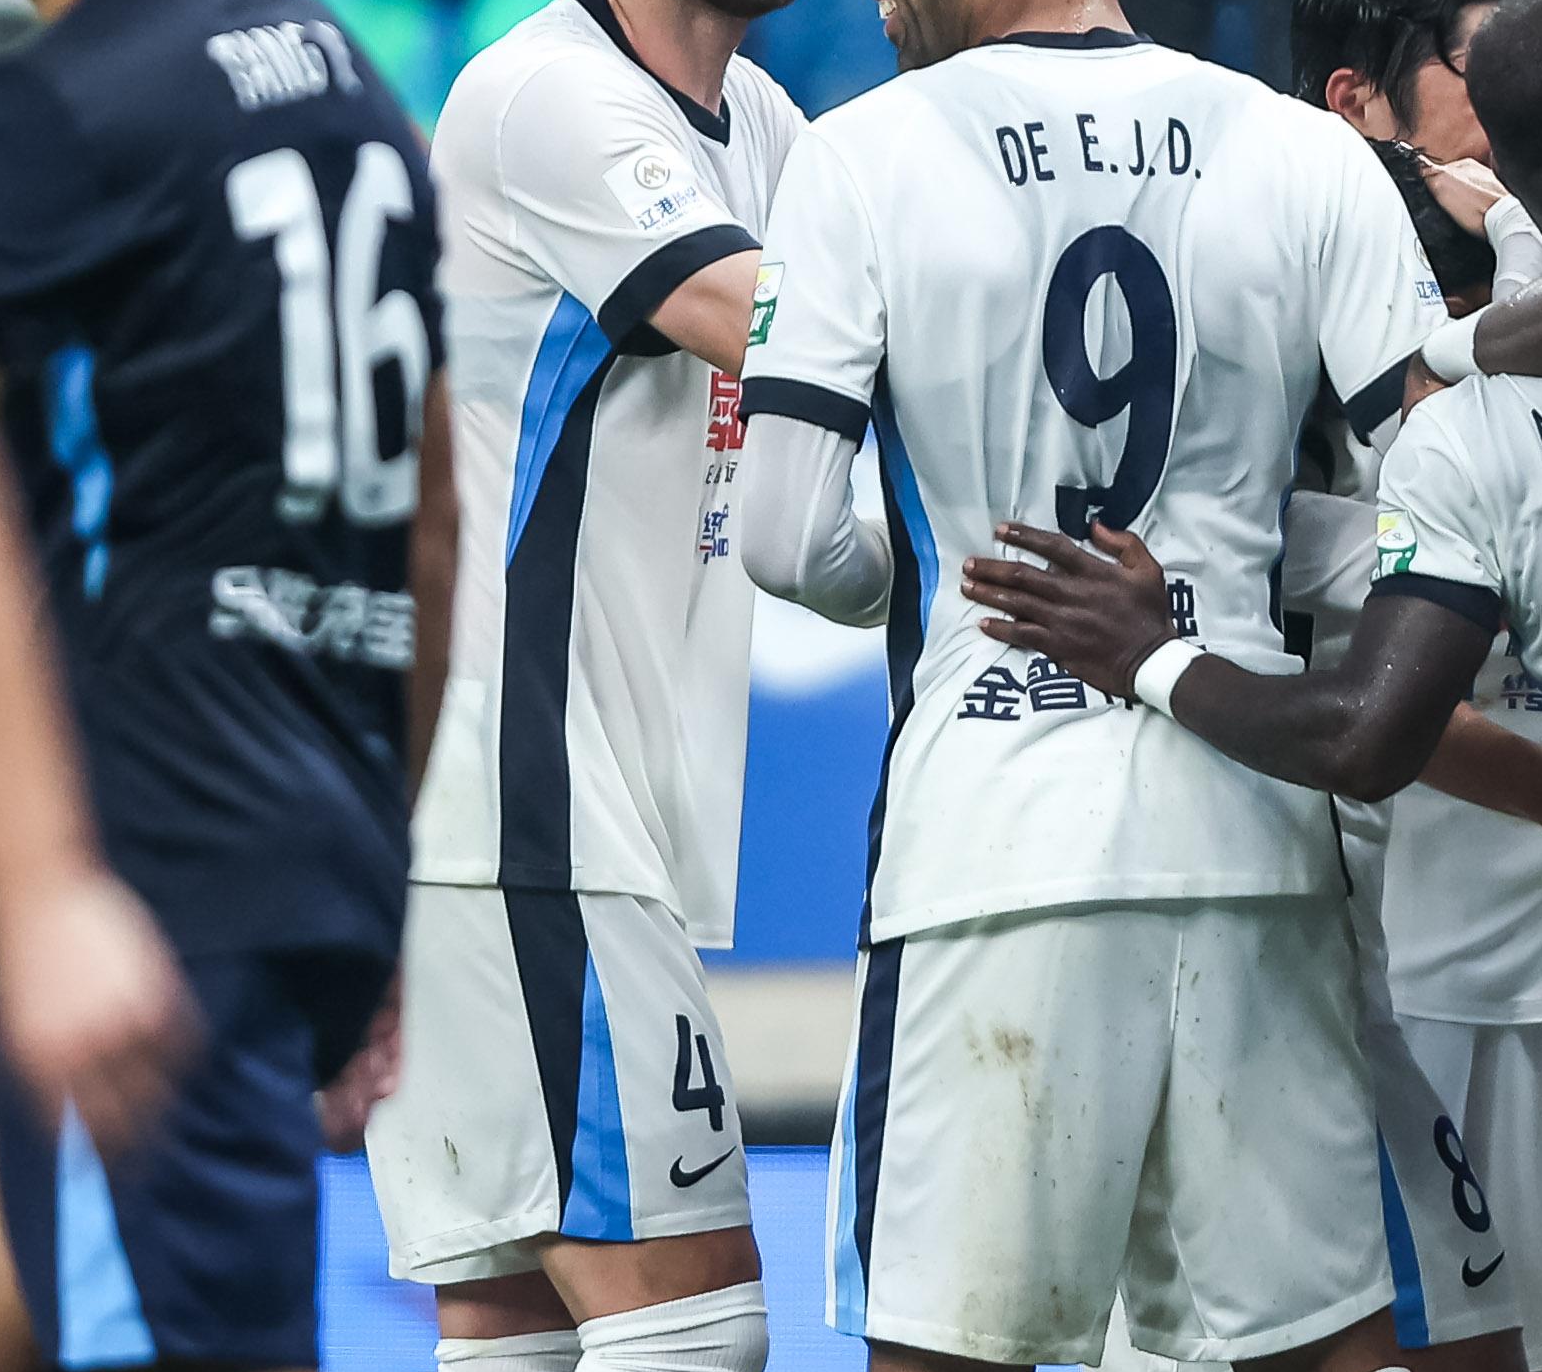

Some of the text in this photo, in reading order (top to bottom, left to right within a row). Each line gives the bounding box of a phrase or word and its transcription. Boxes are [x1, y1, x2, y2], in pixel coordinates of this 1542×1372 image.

[995, 113, 1202, 187] DE E.J.D.
[224, 140, 433, 523] 16
[1042, 224, 1177, 542] 9
[956, 656, 1135, 722] 金普
[671, 1013, 726, 1133] 4
[1432, 1113, 1492, 1234] 8
